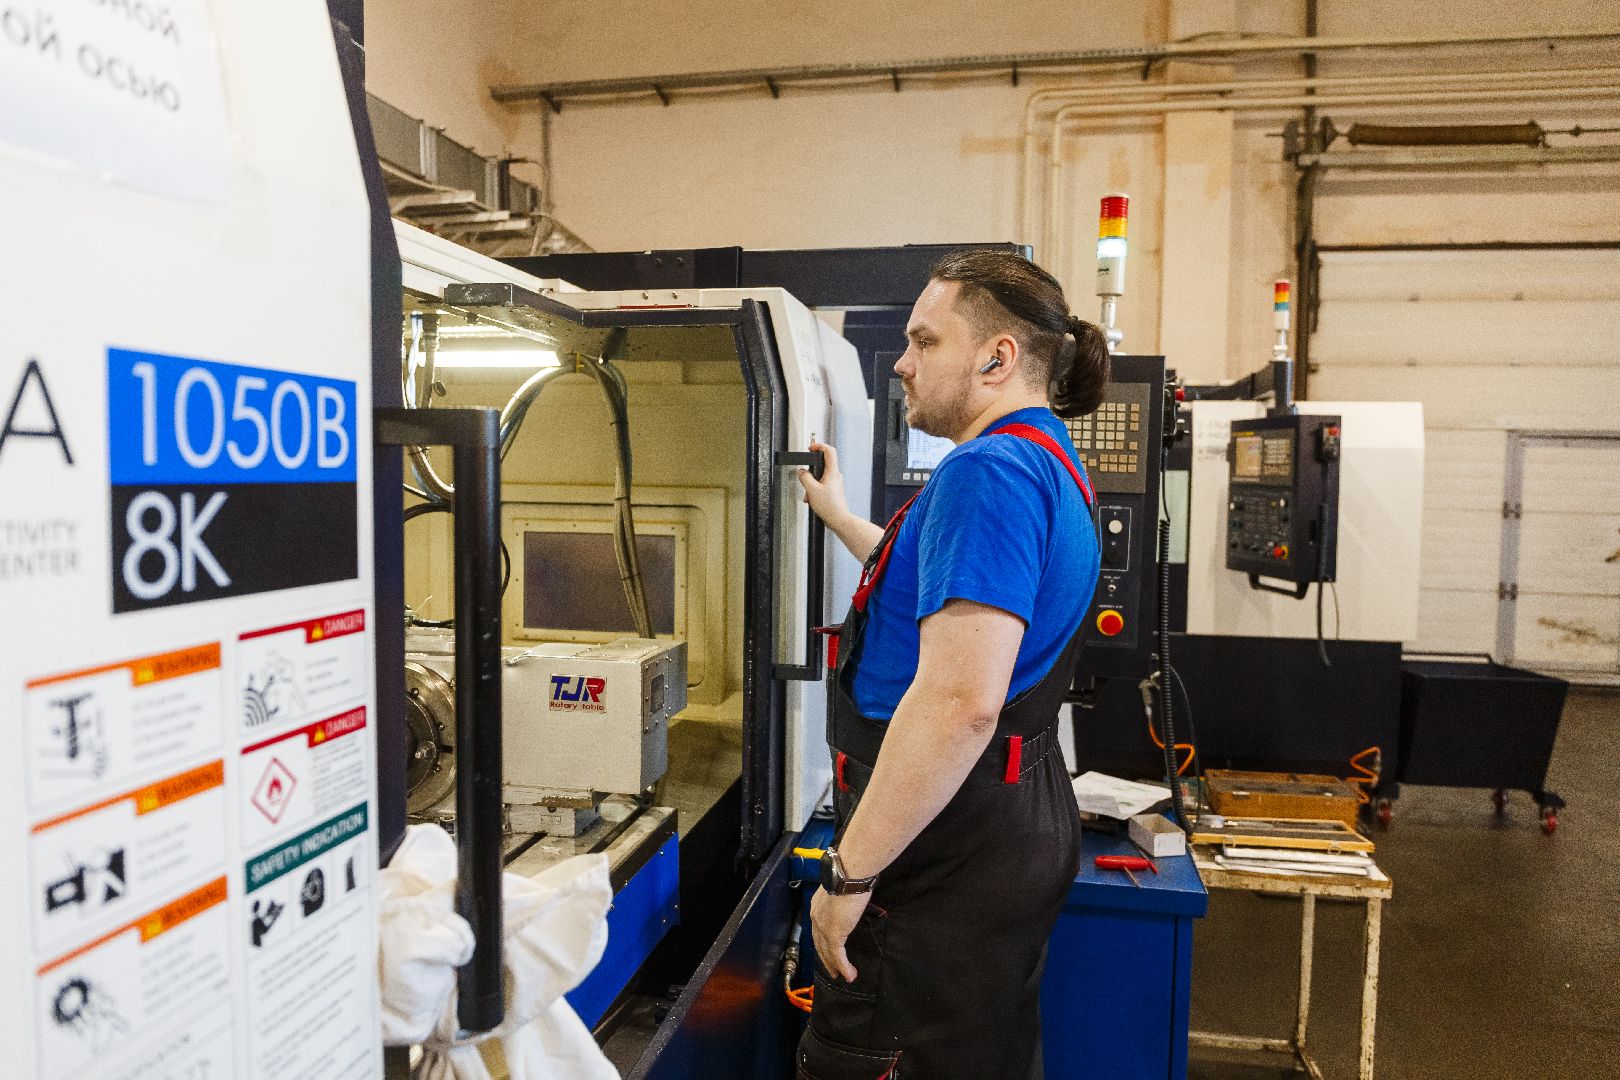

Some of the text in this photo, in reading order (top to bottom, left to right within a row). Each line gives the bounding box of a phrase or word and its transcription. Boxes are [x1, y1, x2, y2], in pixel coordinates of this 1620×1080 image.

[77, 44, 181, 113] осью
[0, 360, 350, 470] A 1050B
[121, 490, 232, 600] 8K
[549, 701, 604, 711] Rotary table
[551, 675, 606, 702] TJR
[251, 811, 365, 884] SAFETY INDICATION
